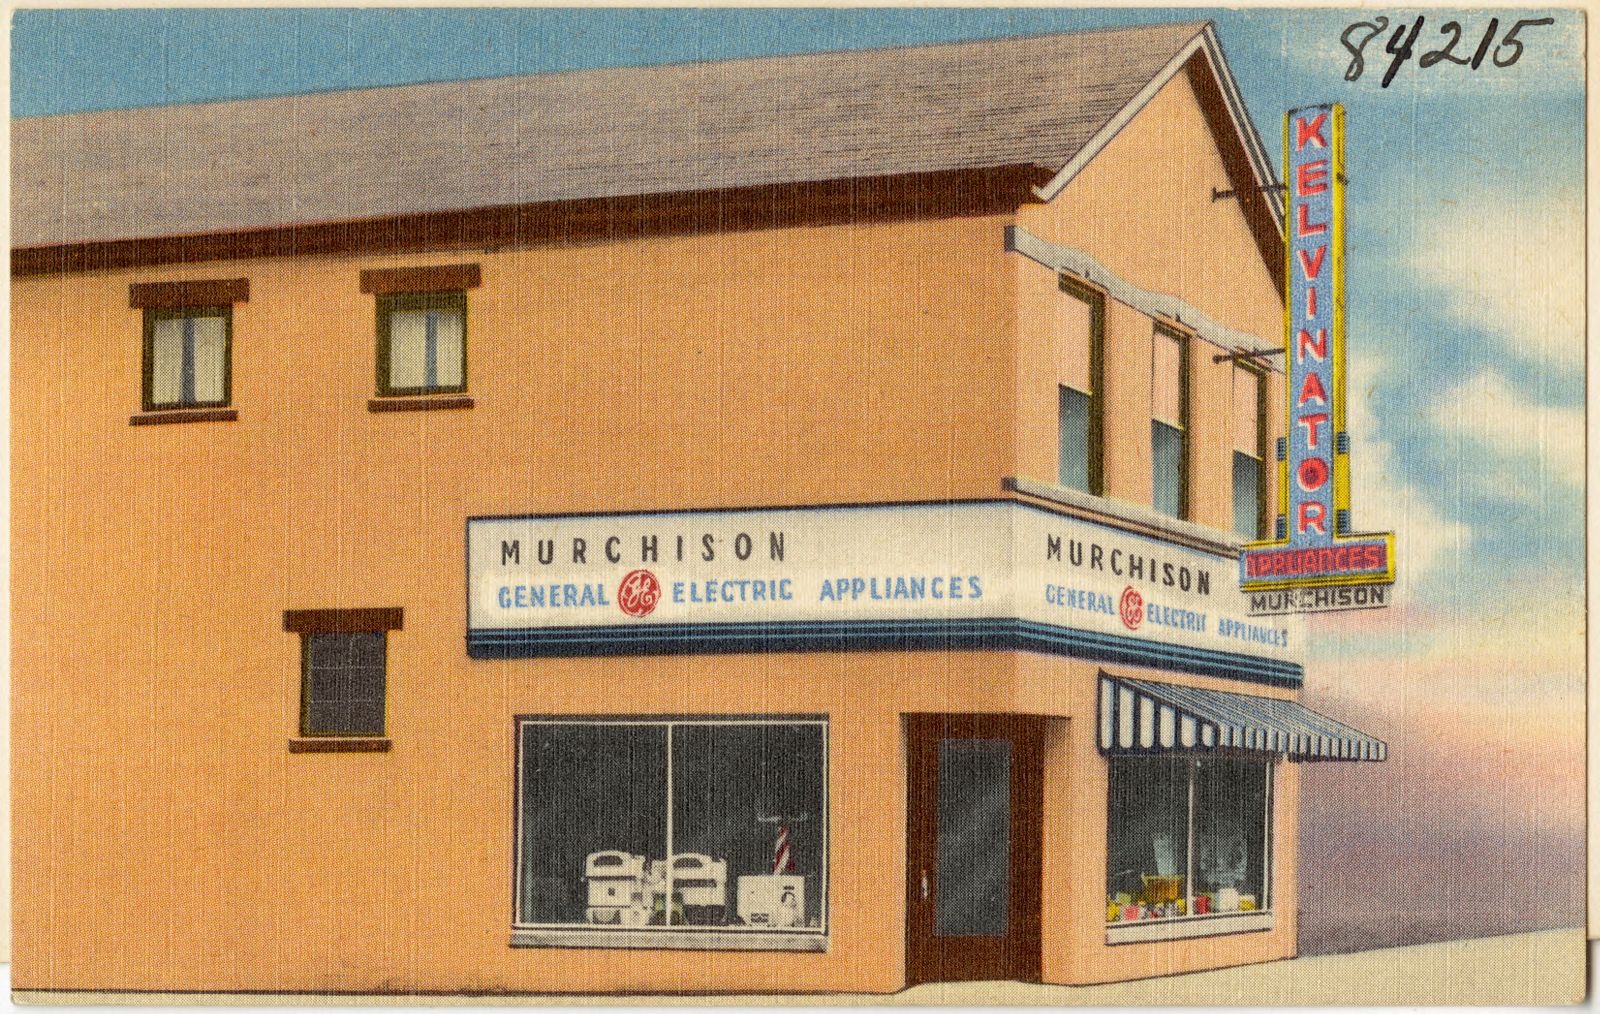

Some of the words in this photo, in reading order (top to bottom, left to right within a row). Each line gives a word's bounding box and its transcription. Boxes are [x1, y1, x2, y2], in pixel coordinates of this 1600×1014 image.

[1340, 16, 1554, 88] 84215
[1296, 113, 1328, 535] KELVINATOR
[501, 531, 785, 565] MURCHISON
[1047, 534, 1210, 595] MURCHISON
[498, 584, 609, 608] GENERAL
[672, 579, 793, 603] ELECTRIC
[819, 575, 983, 601] APPLIANCES
[1045, 584, 1115, 615] GENERAL
[1218, 618, 1288, 647] APPLIANCES
[1250, 586, 1385, 612] MURCHISON
